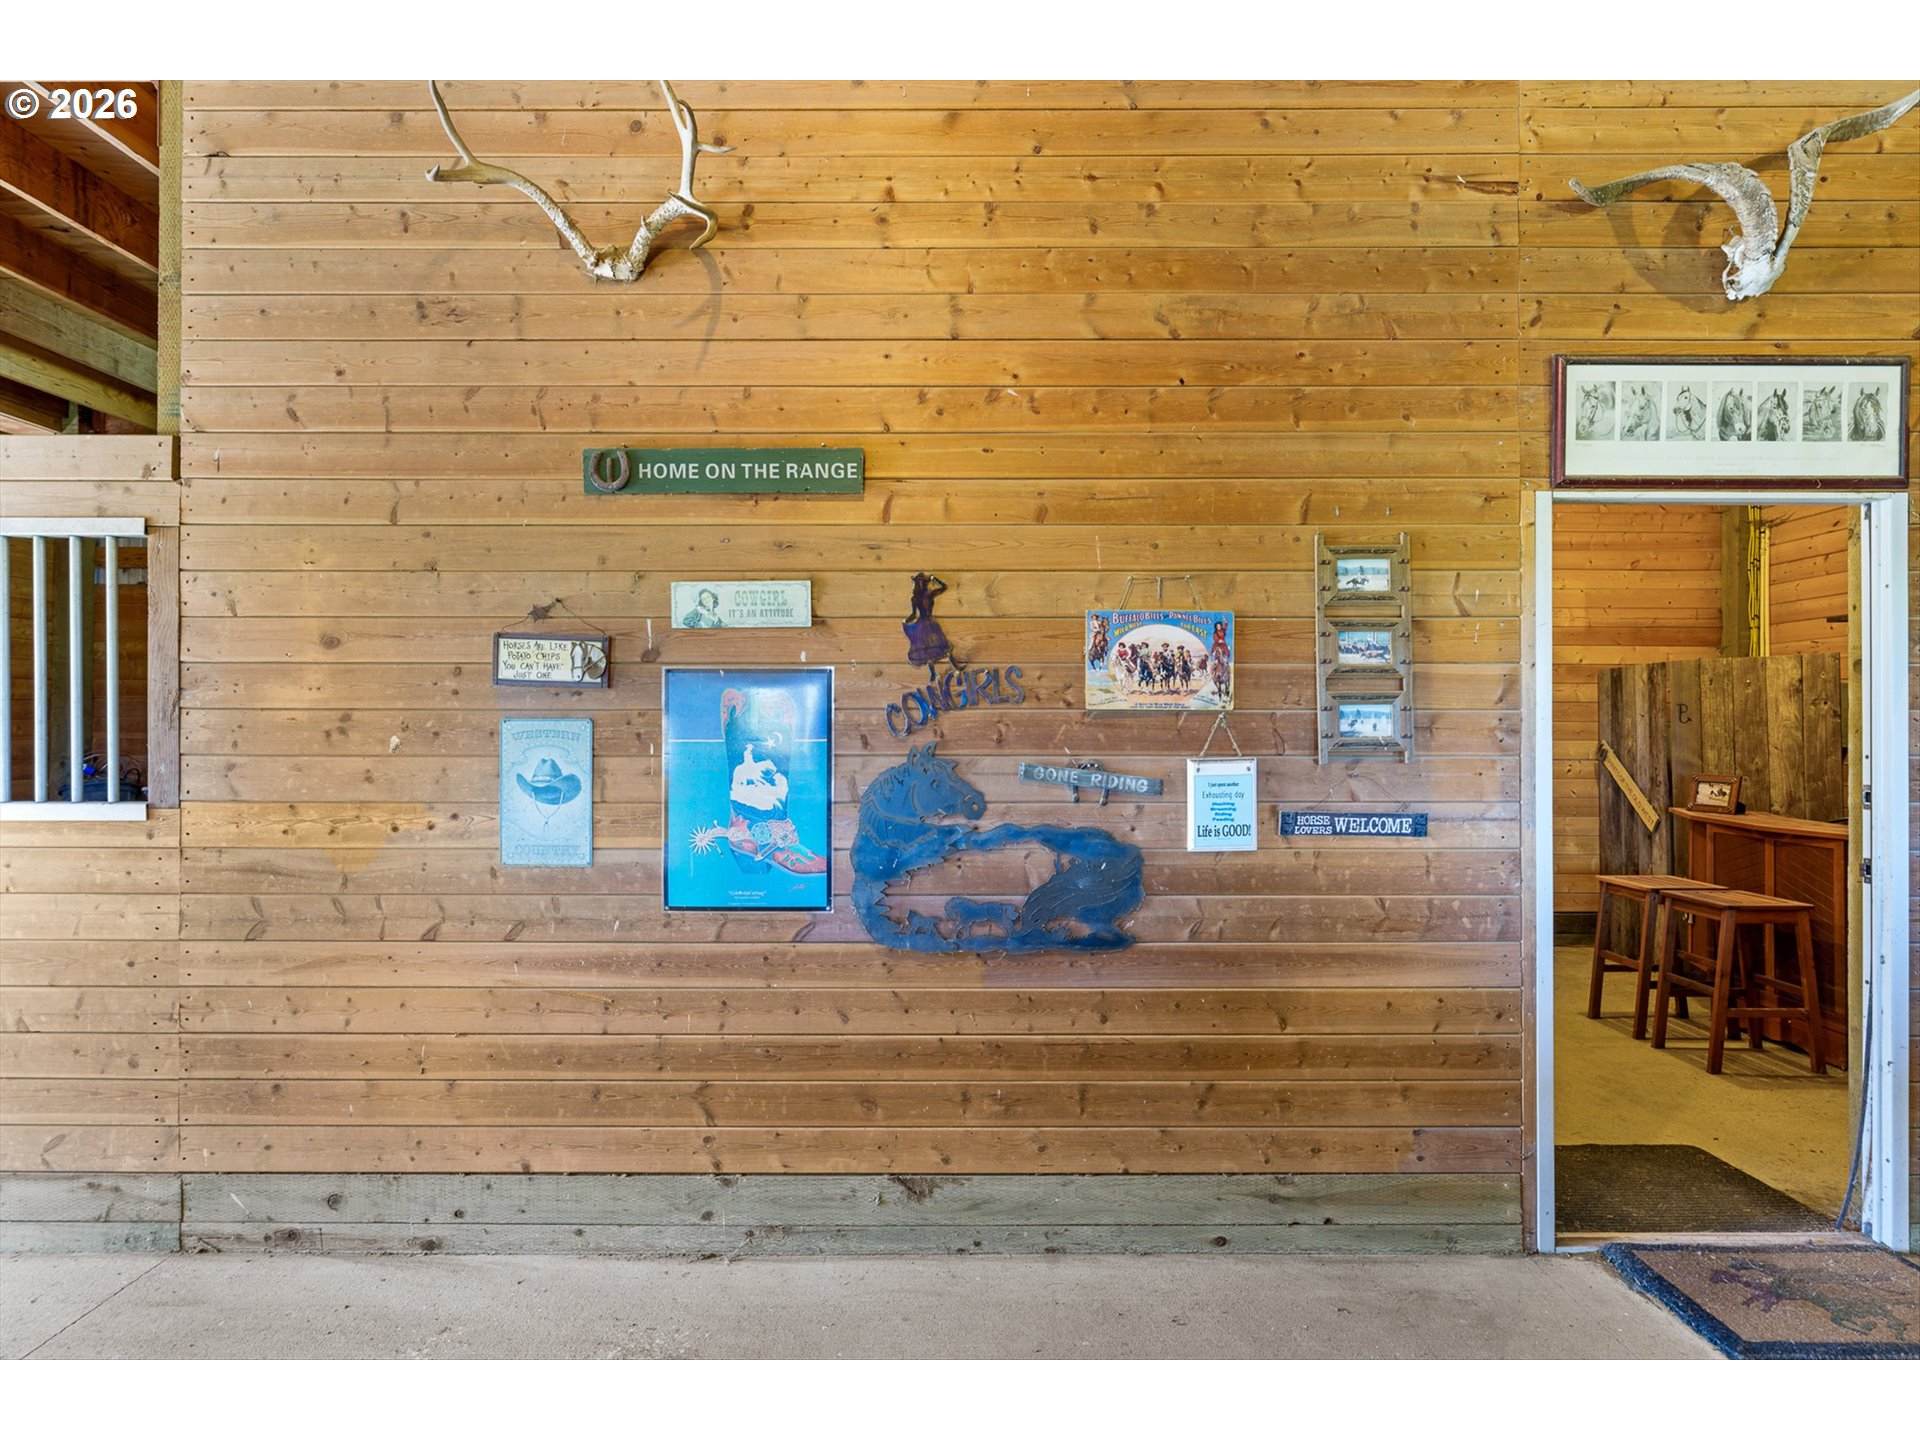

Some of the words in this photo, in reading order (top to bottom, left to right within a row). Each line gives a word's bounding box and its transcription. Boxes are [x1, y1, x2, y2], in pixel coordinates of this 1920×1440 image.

[638, 463, 699, 479] HOME
[705, 463, 736, 479] ON
[741, 463, 780, 479] THE
[786, 463, 858, 479] RANGE
[734, 590, 788, 607] COWGIRL
[728, 609, 744, 618] IT'S
[746, 609, 757, 618] AN
[760, 608, 795, 618] ATTITUDE
[1112, 612, 1144, 624] BUFFALO
[503, 641, 531, 650] HORSES
[550, 642, 568, 651] LIKE
[508, 651, 531, 660] POTATO
[536, 652, 560, 661] CHIPS
[502, 660, 516, 670] YOU
[513, 671, 532, 679] JUST
[884, 665, 1025, 737] COWGIRLS
[511, 729, 582, 743] WESTERN
[1033, 766, 1079, 784] GONE
[1090, 773, 1149, 793] RIDING
[1202, 791, 1233, 801] Exhausting
[1234, 791, 1245, 800] day
[1297, 815, 1330, 825] HORSE
[1334, 817, 1413, 834] WELCOME
[1197, 825, 1213, 837] Life
[1214, 825, 1221, 837] is
[1222, 824, 1251, 837] GOOD!
[1294, 826, 1332, 835] LOVERS
